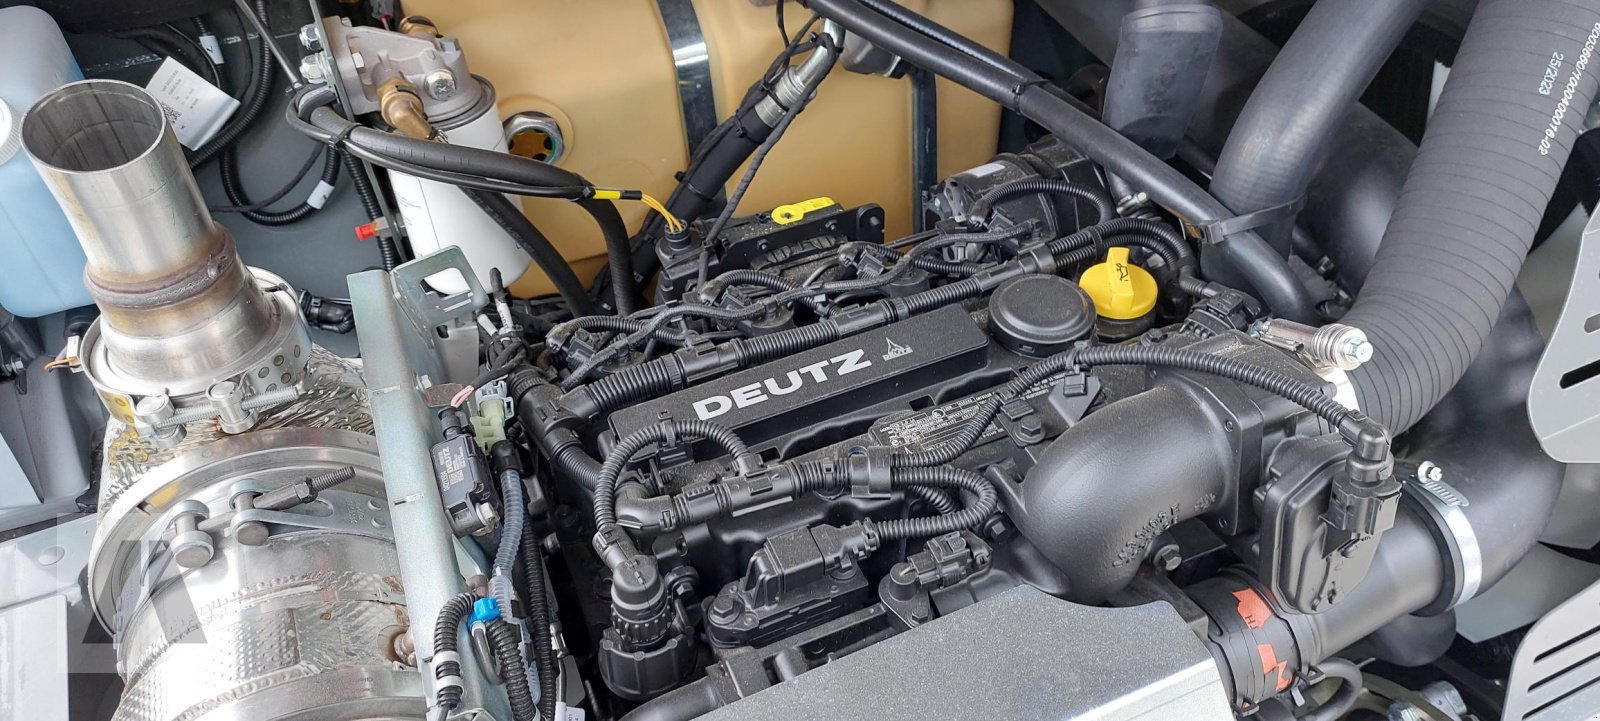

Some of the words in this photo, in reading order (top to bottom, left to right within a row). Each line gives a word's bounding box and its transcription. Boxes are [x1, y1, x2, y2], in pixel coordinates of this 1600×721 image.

[1538, 51, 1564, 96] 25/2023
[692, 348, 872, 421] DEUTZ
[442, 446, 454, 474] DEUTZ
